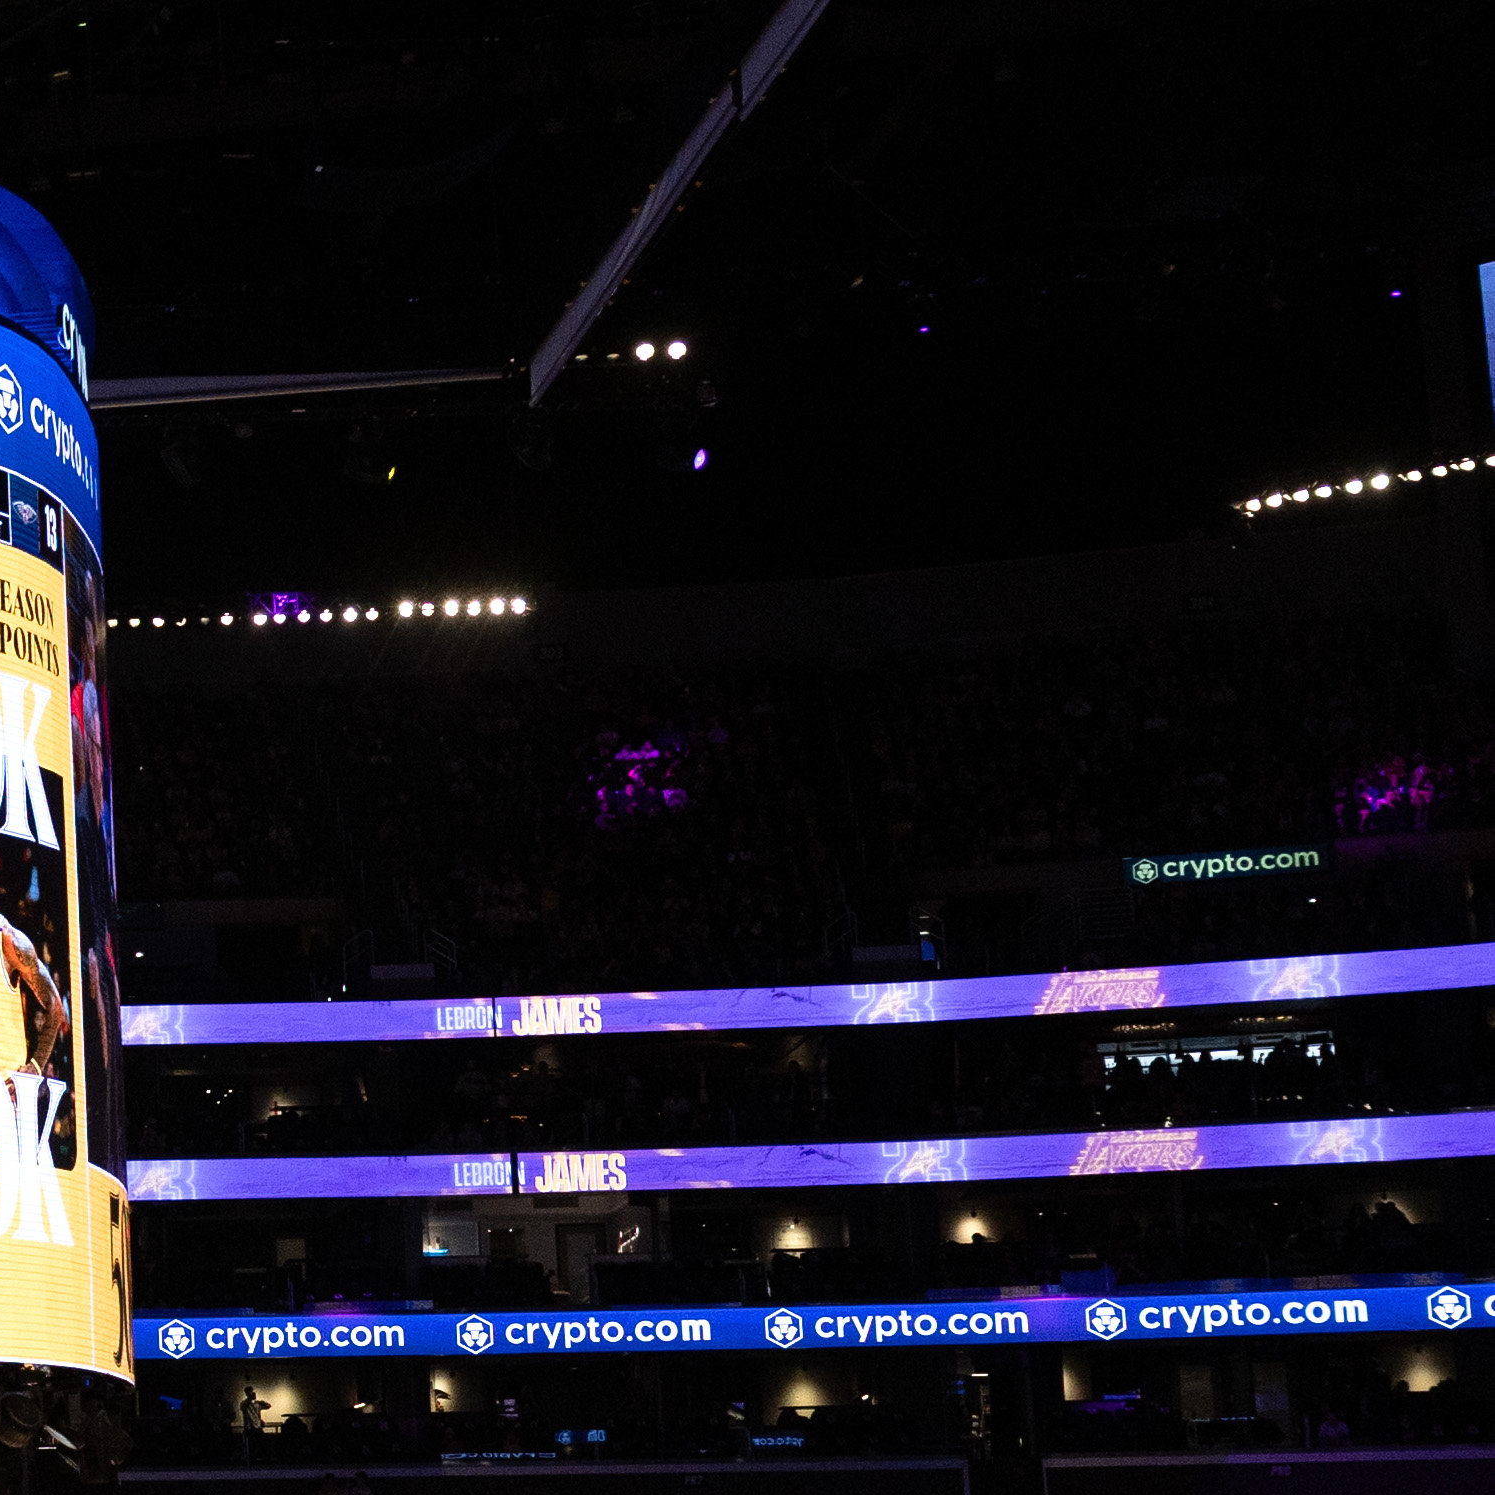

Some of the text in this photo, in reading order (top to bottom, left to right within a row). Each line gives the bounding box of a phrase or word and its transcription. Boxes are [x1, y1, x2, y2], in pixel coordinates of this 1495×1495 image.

[43, 503, 59, 553] 13
[0, 621, 60, 679] POINTS
[1162, 848, 1320, 879] crypto.com
[436, 996, 602, 1038] LEBRON JAMES
[454, 1153, 627, 1195] LEBRON JAMES
[504, 1315, 712, 1349] crypto.com
[813, 1307, 1030, 1344] crypto.com
[1137, 1298, 1370, 1333] crypto.com
[205, 1319, 406, 1354] crypto.com
